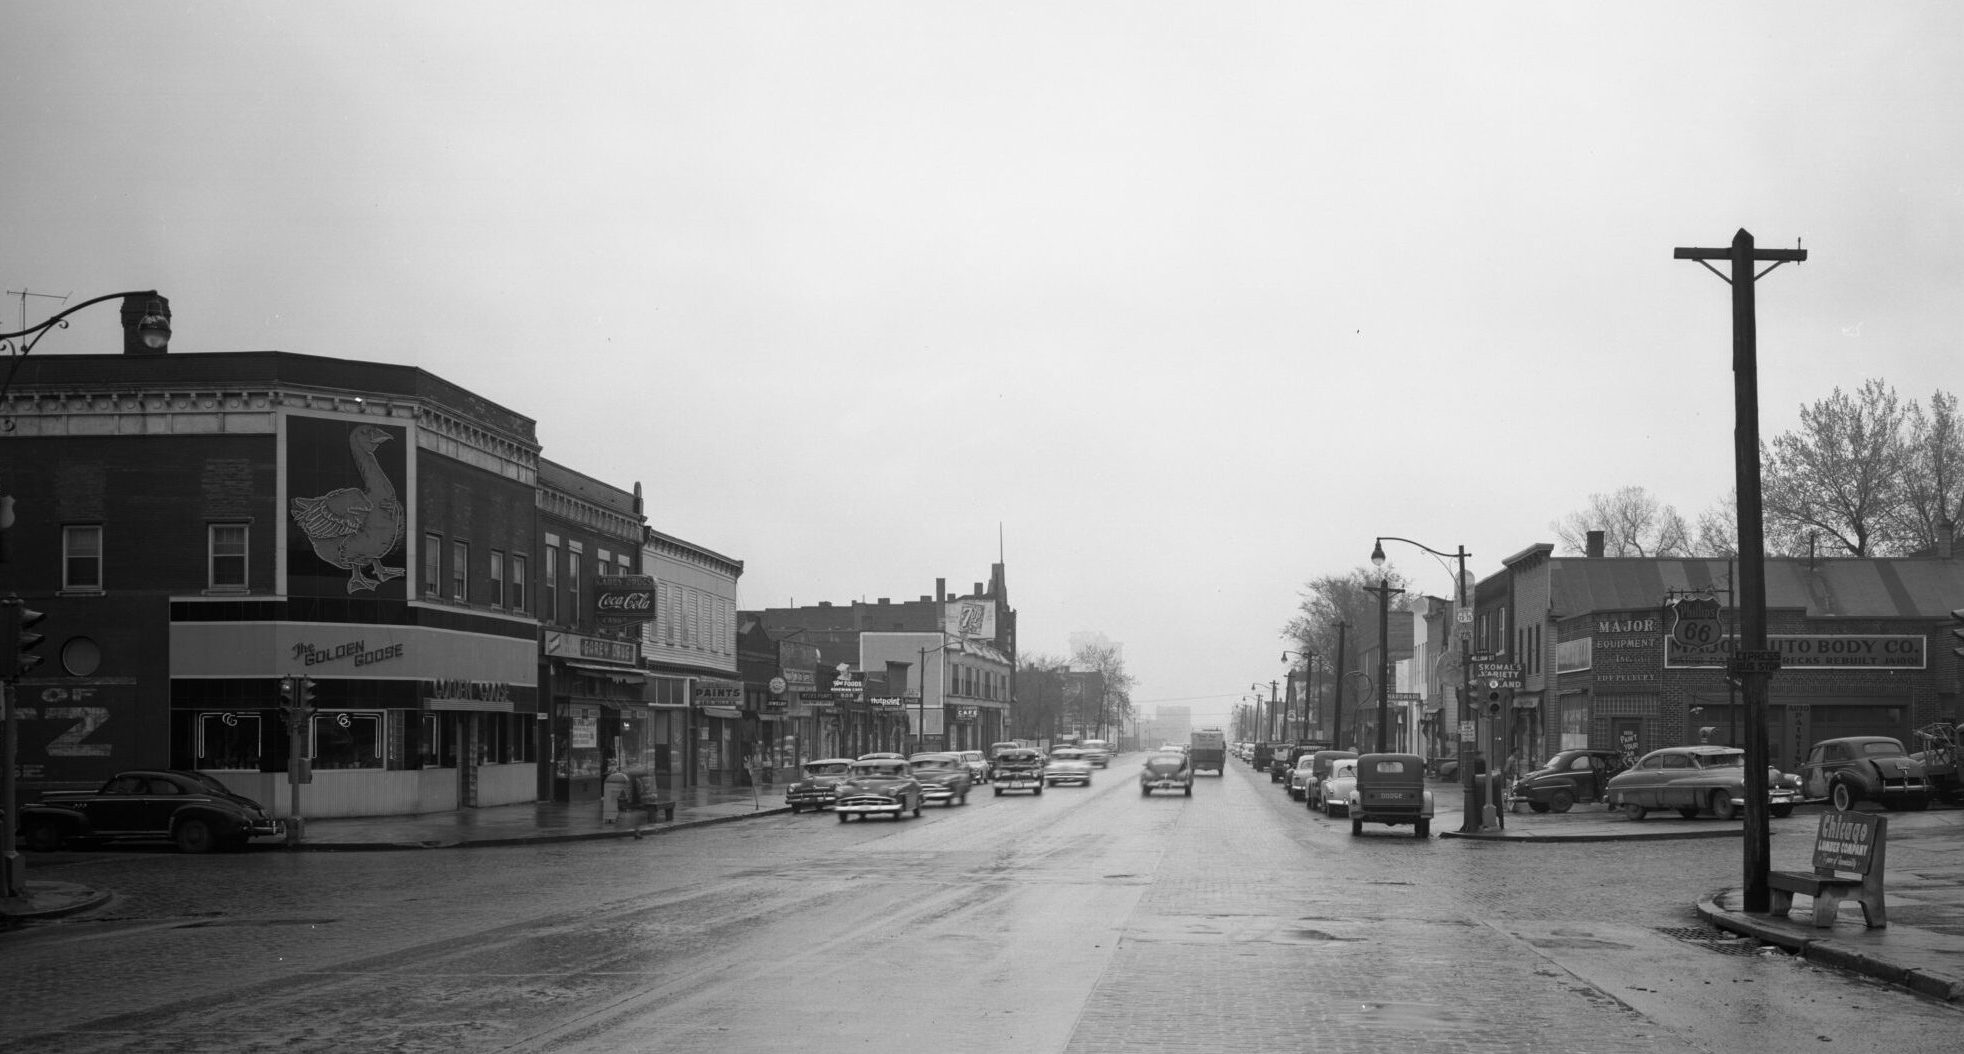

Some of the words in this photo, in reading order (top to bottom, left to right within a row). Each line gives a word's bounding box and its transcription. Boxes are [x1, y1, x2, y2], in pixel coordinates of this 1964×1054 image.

[1679, 601, 1715, 618] Phillips
[1599, 619, 1654, 632] MAJOR
[1685, 622, 1711, 642] 66
[292, 642, 316, 660] The
[1597, 639, 1656, 649] EQUIPMENT
[1817, 640, 1880, 653] BODY
[1884, 640, 1919, 653] CO.
[305, 640, 364, 666] GOLDEN
[354, 644, 403, 667] GOOSE
[1782, 657, 1820, 665] RECKS
[1826, 656, 1878, 665] REBUILT
[41, 688, 97, 702] OF
[696, 688, 741, 697] PAINTS
[1822, 814, 1869, 844] Chicago
[1818, 839, 1841, 853] LUMBER
[1840, 841, 1869, 856] COMPANY
